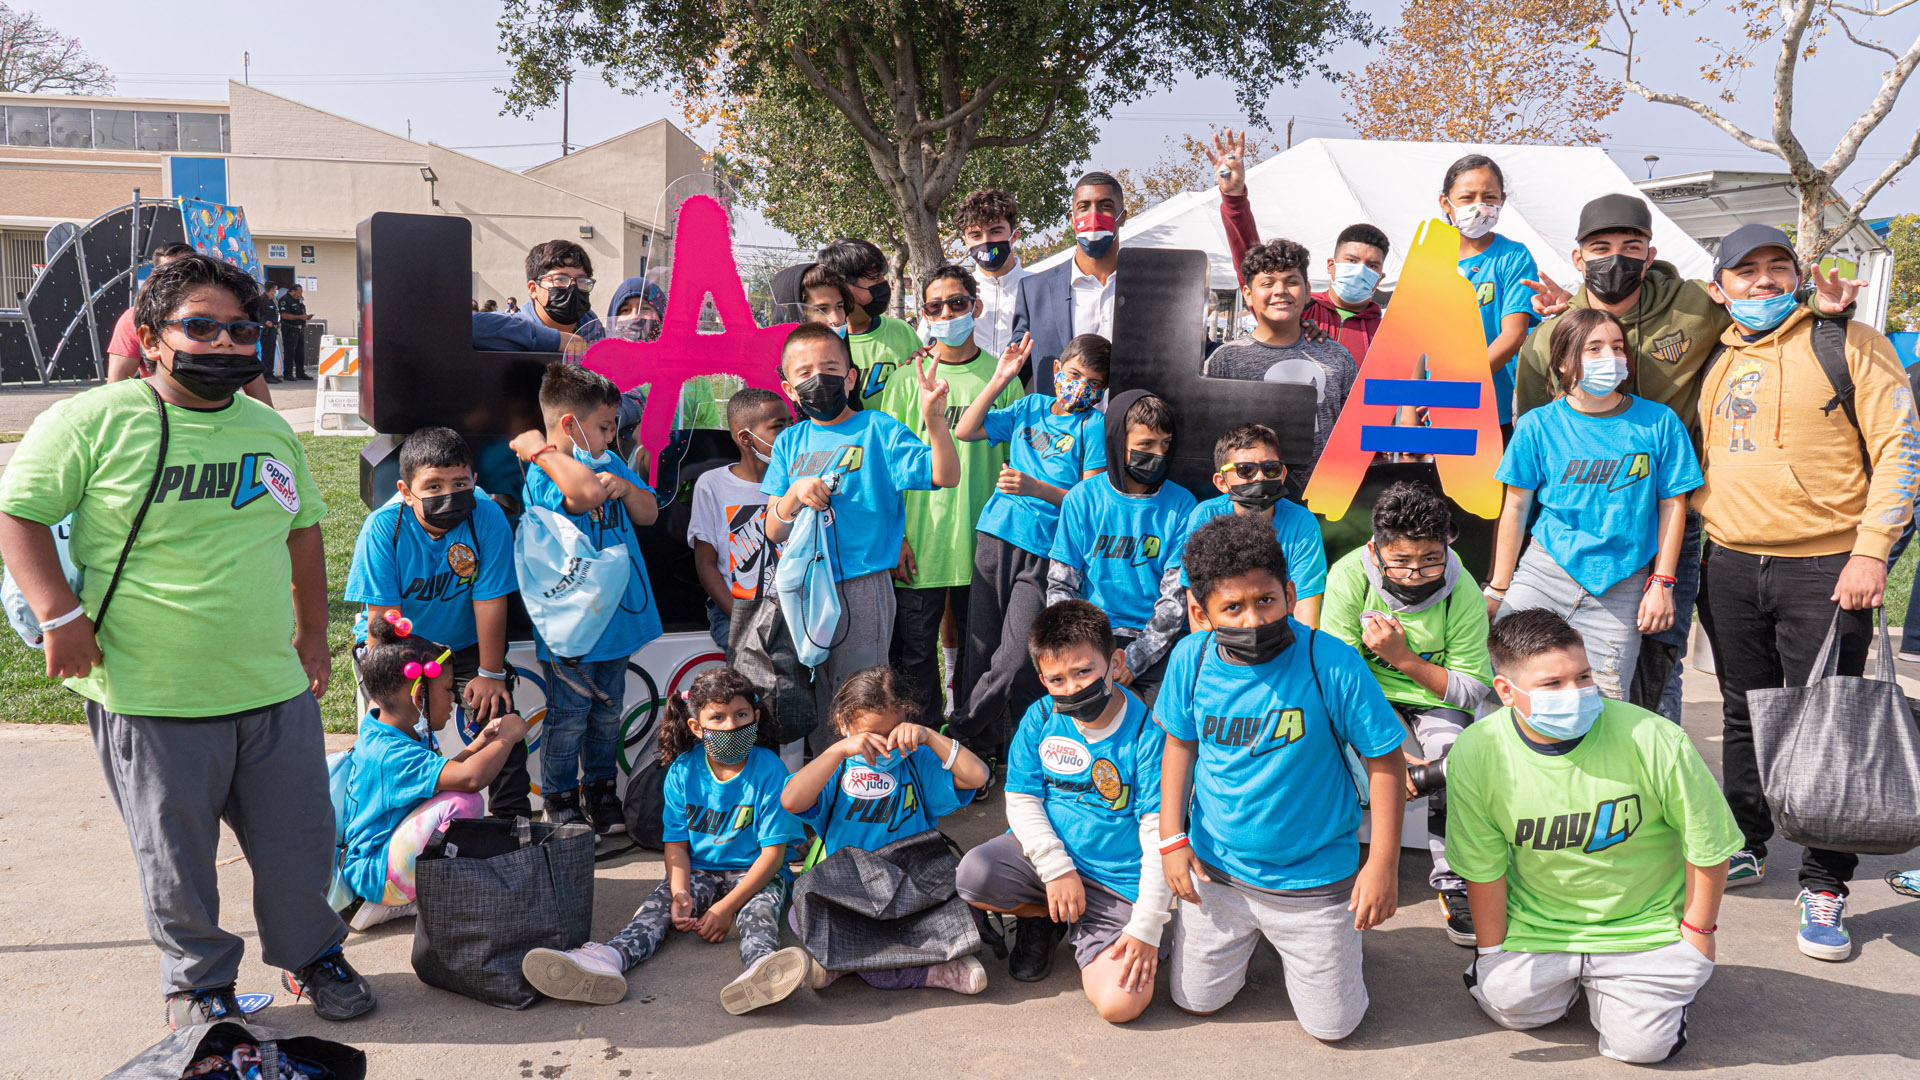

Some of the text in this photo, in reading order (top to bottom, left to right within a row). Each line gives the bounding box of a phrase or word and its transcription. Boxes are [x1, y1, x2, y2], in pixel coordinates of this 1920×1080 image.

[977, 250, 991, 262] PLAY
[789, 451, 834, 478] PLAY
[1561, 452, 1651, 492] PLAY LA
[153, 462, 237, 503] PLAY
[1092, 534, 1137, 559] PLAY
[1202, 707, 1306, 758] PLAY LA
[1056, 745, 1076, 757] usa
[1058, 754, 1084, 767] judo
[860, 772, 880, 781] usa
[865, 778, 890, 791] judo
[686, 803, 728, 836] PLAY
[1515, 794, 1643, 855] PLAY LA
